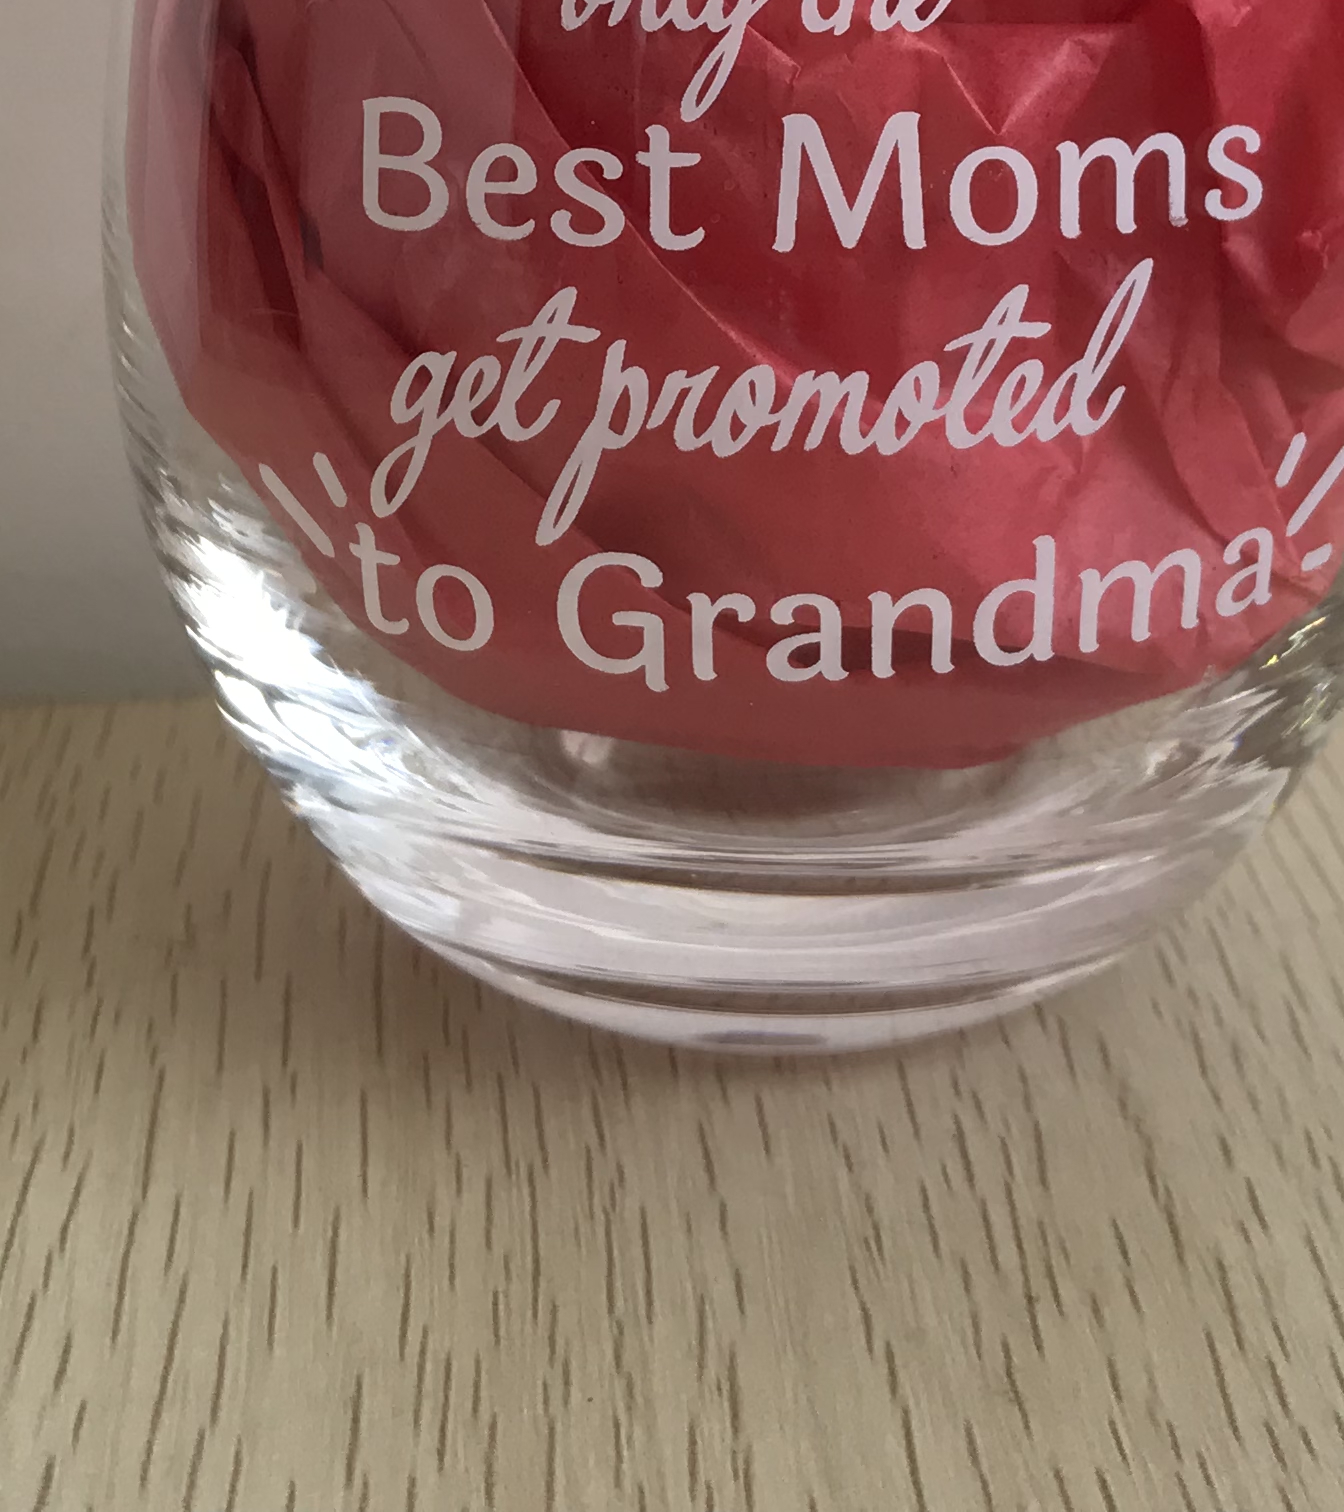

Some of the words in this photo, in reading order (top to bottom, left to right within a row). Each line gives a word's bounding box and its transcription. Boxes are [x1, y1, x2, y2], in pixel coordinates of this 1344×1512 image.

[360, 95, 707, 252] Best
[770, 110, 1264, 253] Moms
[369, 285, 601, 518] get
[535, 256, 1154, 546] promoted
[347, 519, 495, 652] to
[556, 524, 1273, 692] Grandma
